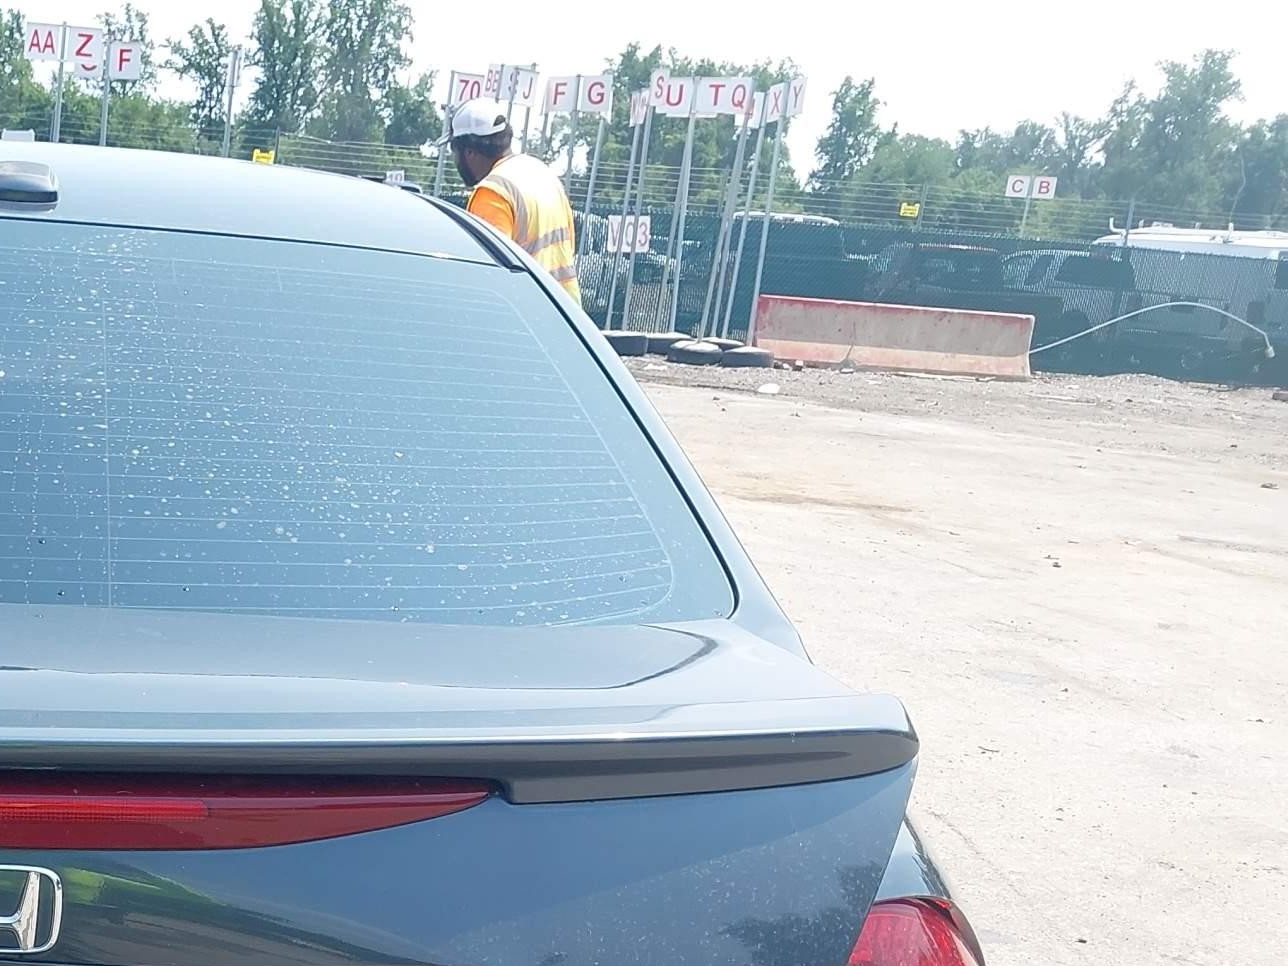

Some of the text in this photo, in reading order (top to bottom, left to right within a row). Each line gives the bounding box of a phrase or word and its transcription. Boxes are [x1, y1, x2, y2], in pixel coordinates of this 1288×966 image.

[28, 29, 55, 54] AA
[75, 33, 94, 57] Z
[118, 48, 132, 72] F
[459, 79, 481, 101] 70
[553, 82, 568, 106] F
[587, 81, 605, 105] G
[655, 75, 665, 99] S
[666, 84, 684, 107] U
[709, 84, 726, 106] T
[732, 84, 745, 109] Q
[793, 84, 804, 109] Y
[770, 90, 782, 115] X
[1012, 180, 1024, 193] C
[1038, 181, 1050, 194] B
